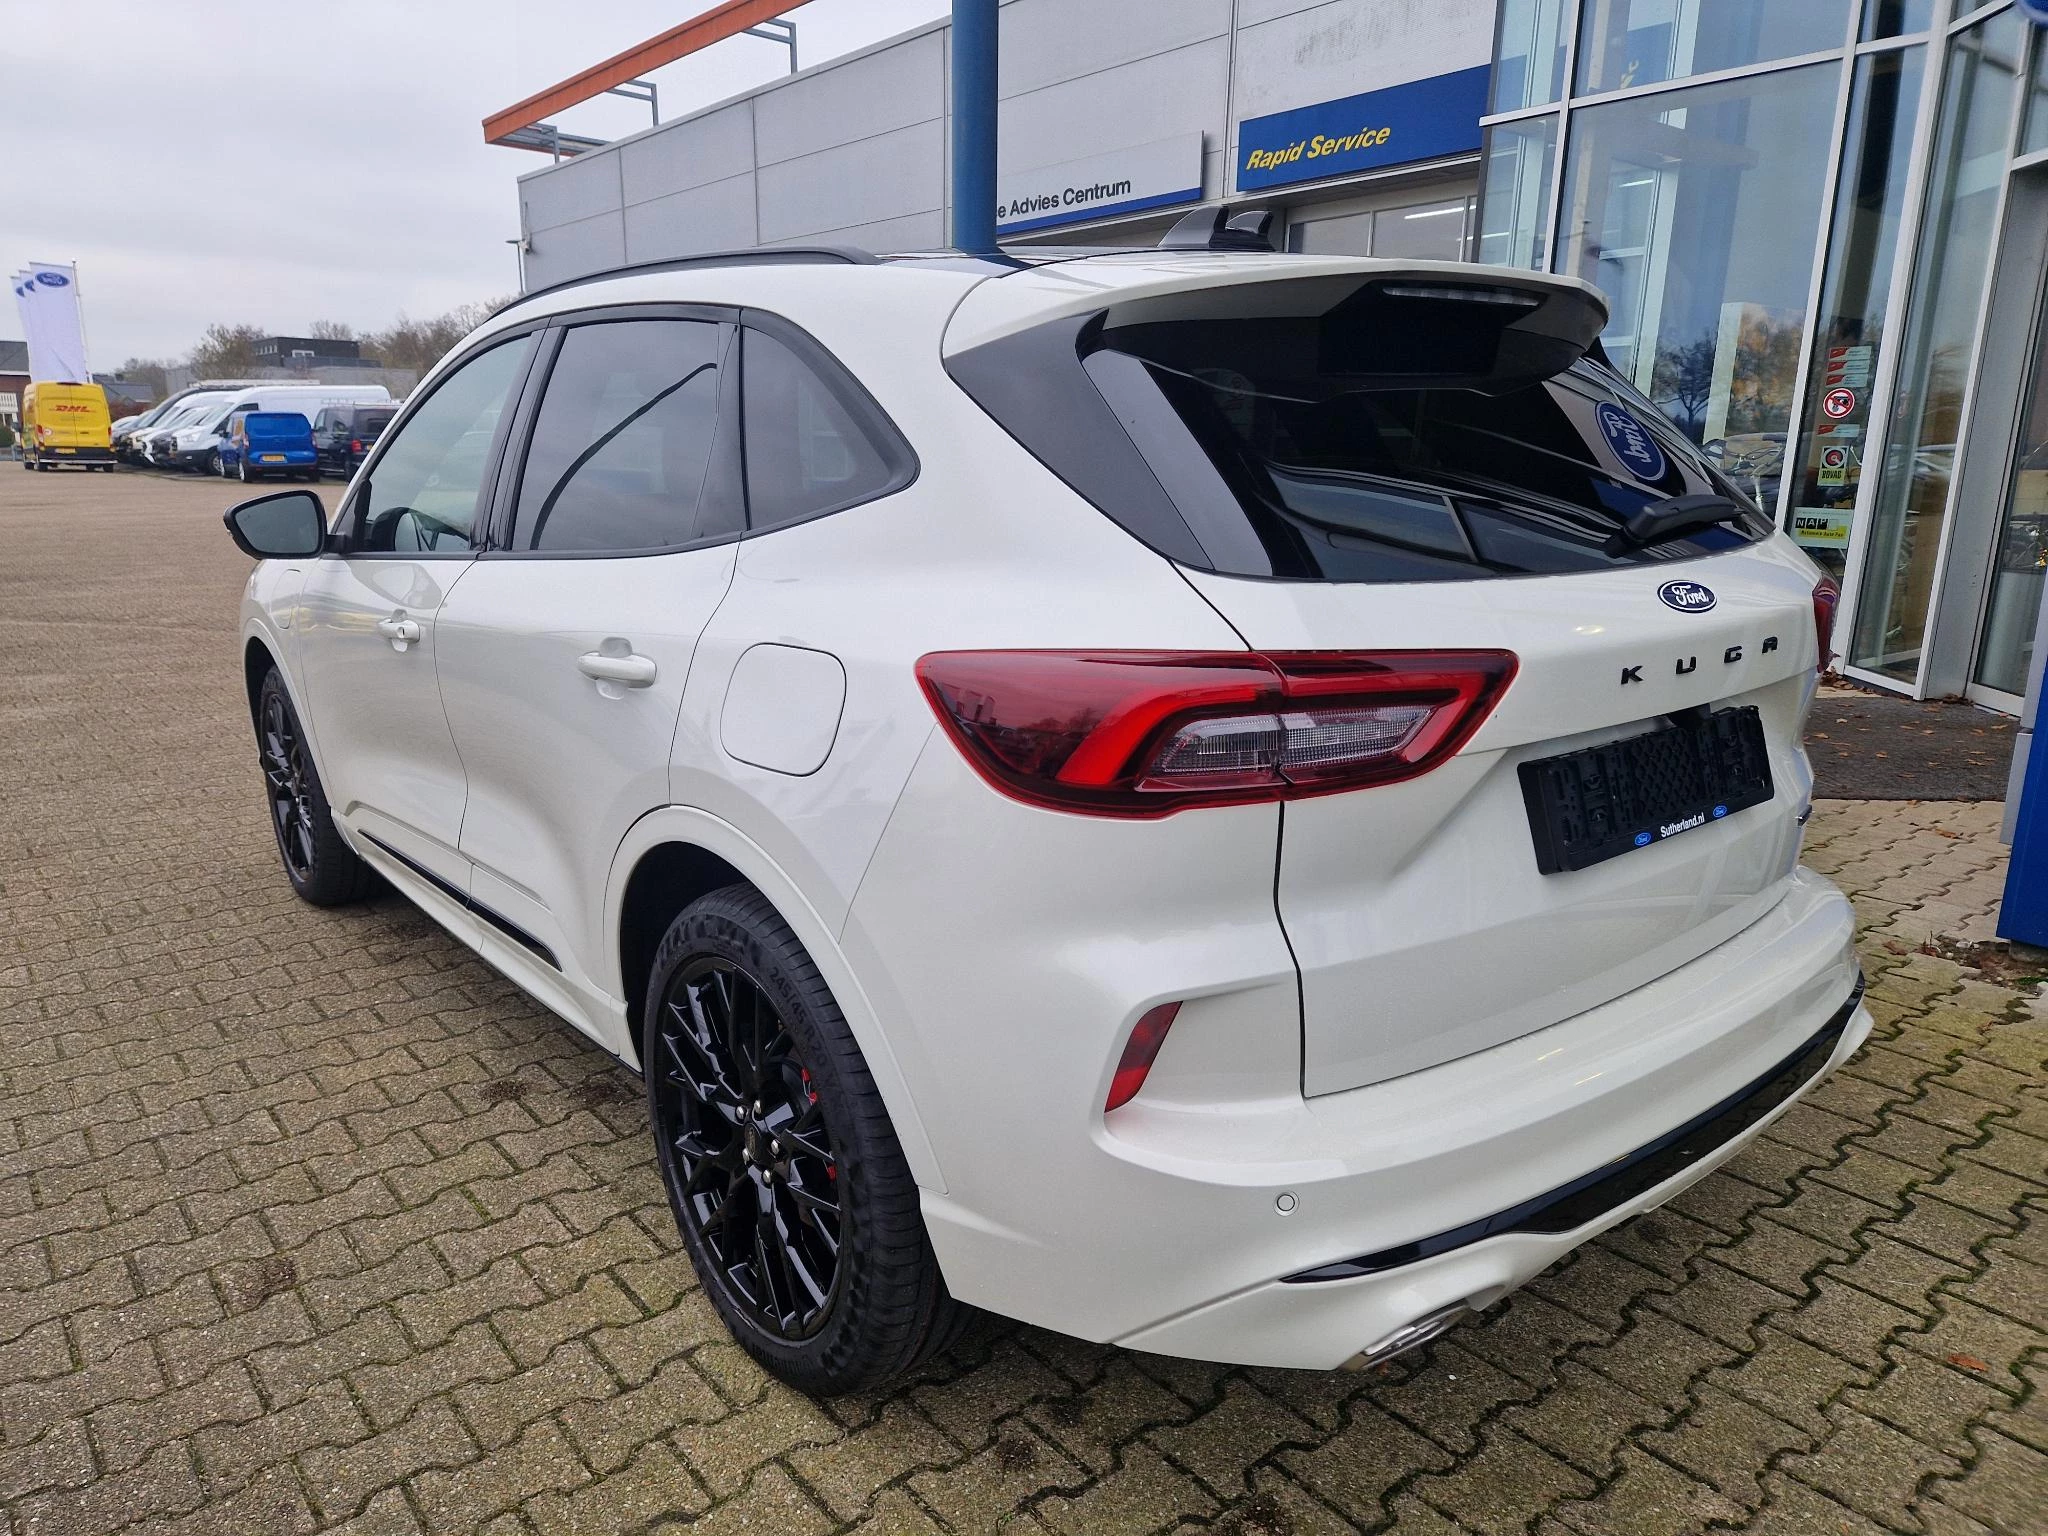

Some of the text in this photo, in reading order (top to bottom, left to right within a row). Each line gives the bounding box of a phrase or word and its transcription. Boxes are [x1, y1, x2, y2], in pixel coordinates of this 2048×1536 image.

[1246, 126, 1391, 170] Rapid Service
[1009, 194, 1059, 217] Advies
[1062, 180, 1131, 206] Centrum
[1796, 518, 1828, 528] NAP
[1669, 583, 1711, 607] Ford
[1621, 636, 1778, 685] KUGA
[1660, 811, 1705, 838] Sutherland.nl
